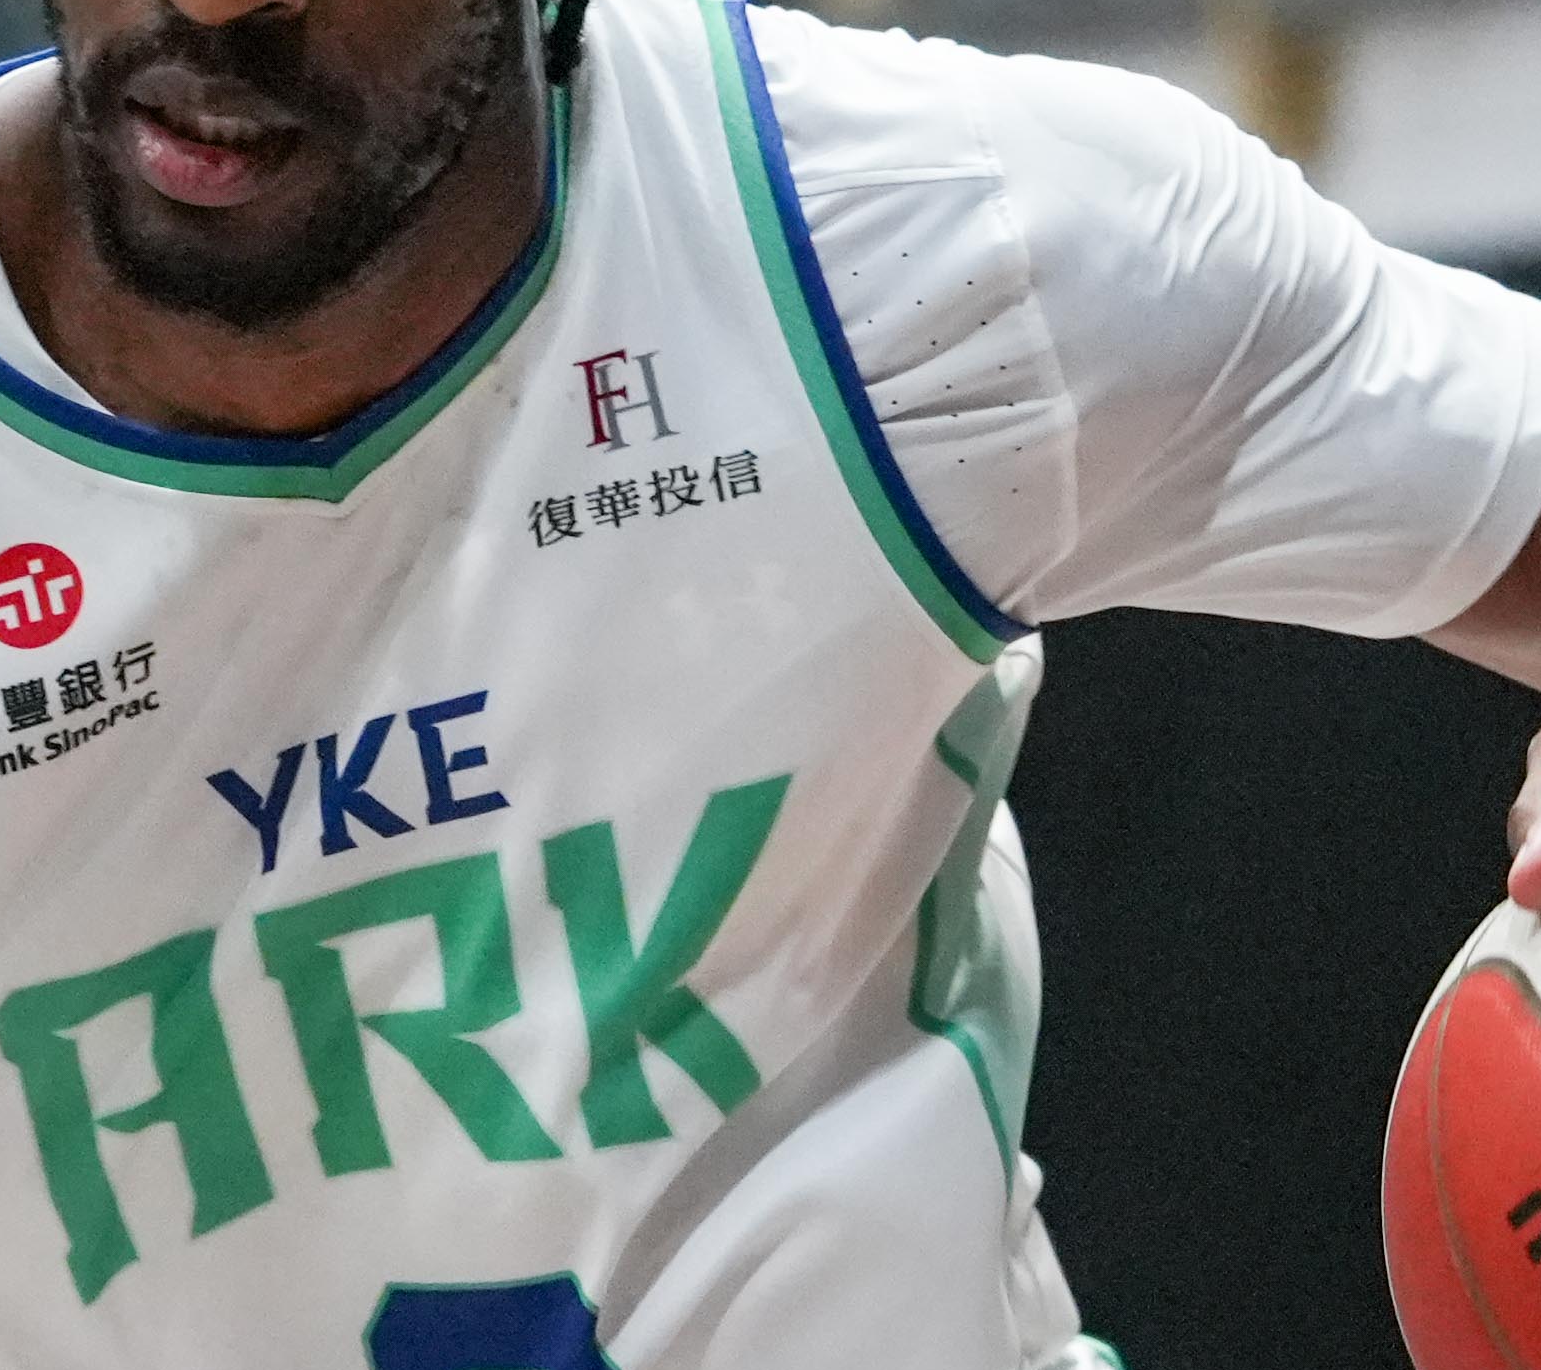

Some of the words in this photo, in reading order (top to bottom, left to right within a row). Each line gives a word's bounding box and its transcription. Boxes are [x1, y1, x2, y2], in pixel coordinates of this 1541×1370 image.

[528, 449, 762, 549] 復華投信
[205, 689, 511, 875] YKE
